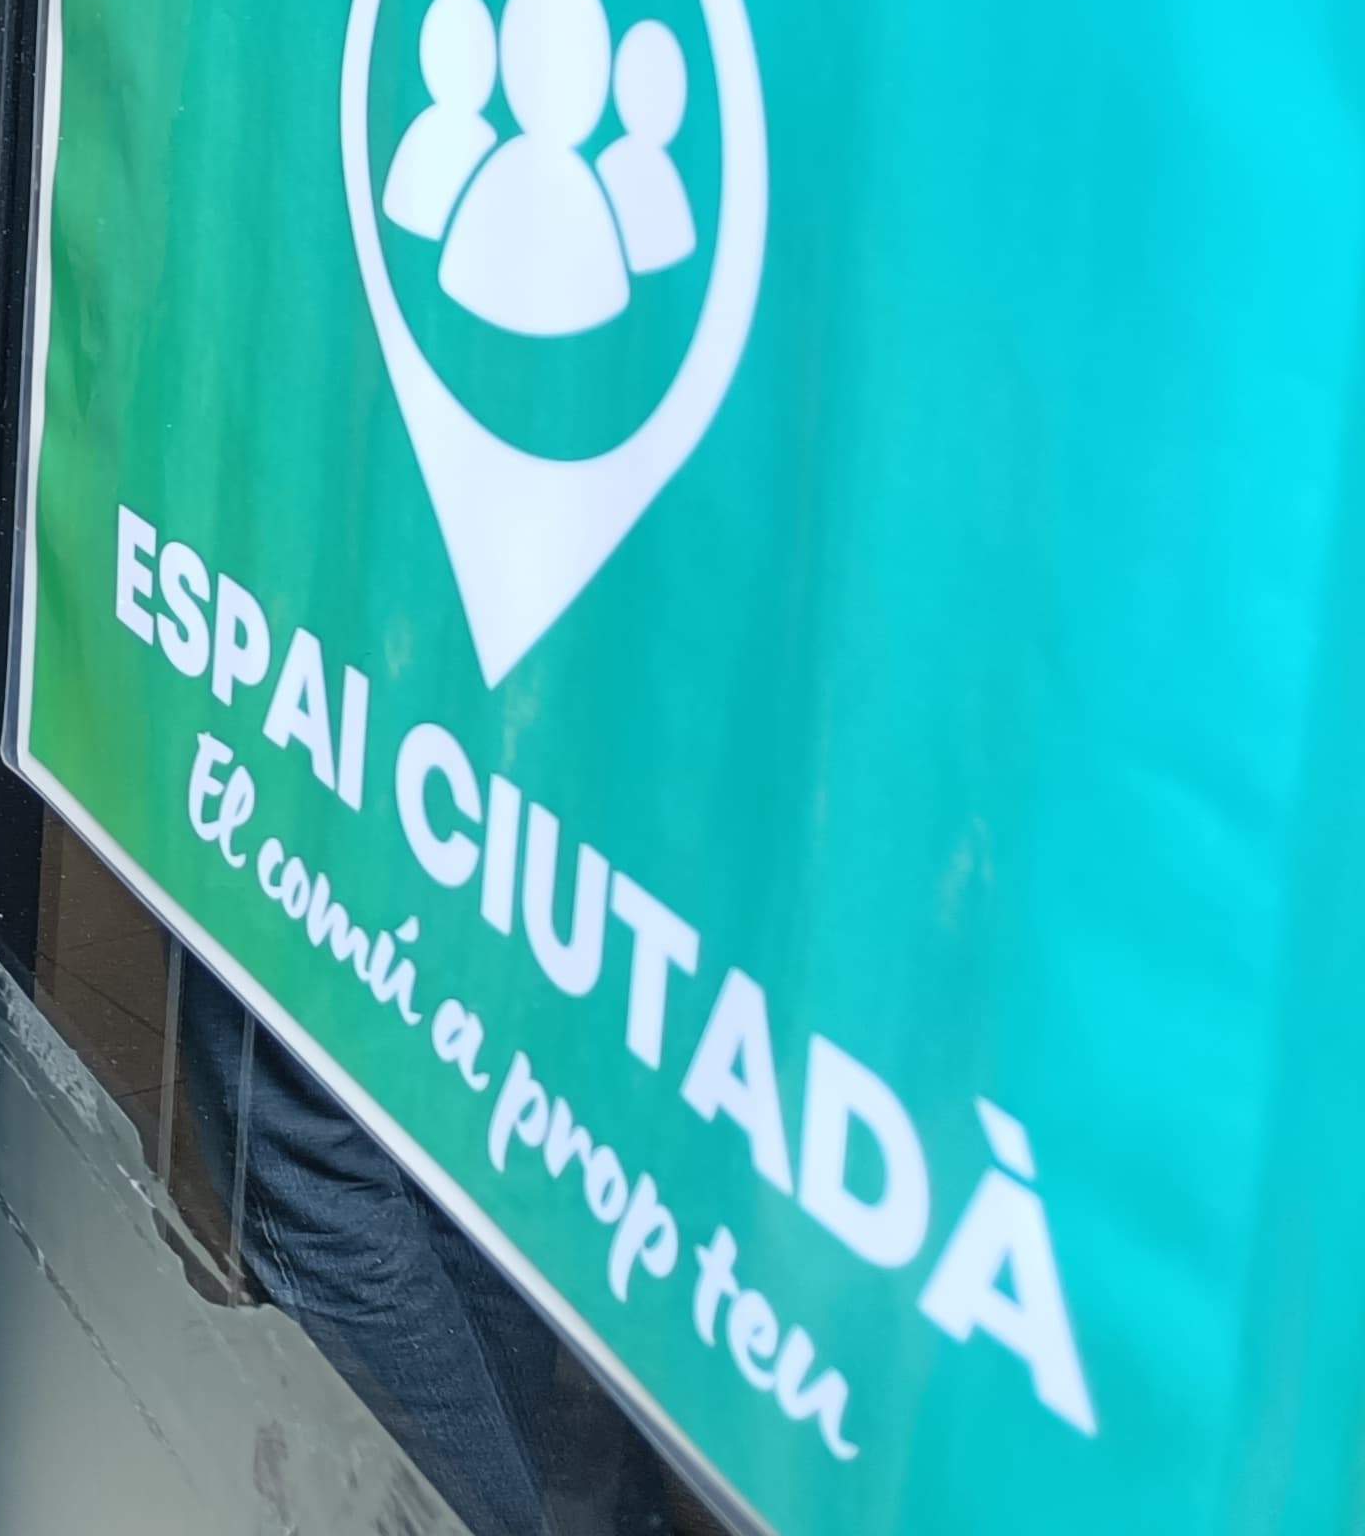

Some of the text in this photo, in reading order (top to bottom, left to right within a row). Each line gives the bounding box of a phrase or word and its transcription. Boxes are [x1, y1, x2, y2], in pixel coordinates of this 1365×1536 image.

[114, 504, 1098, 1438] ESPAI CIUTADÀ
[187, 731, 860, 1461] El comú a prop teu
